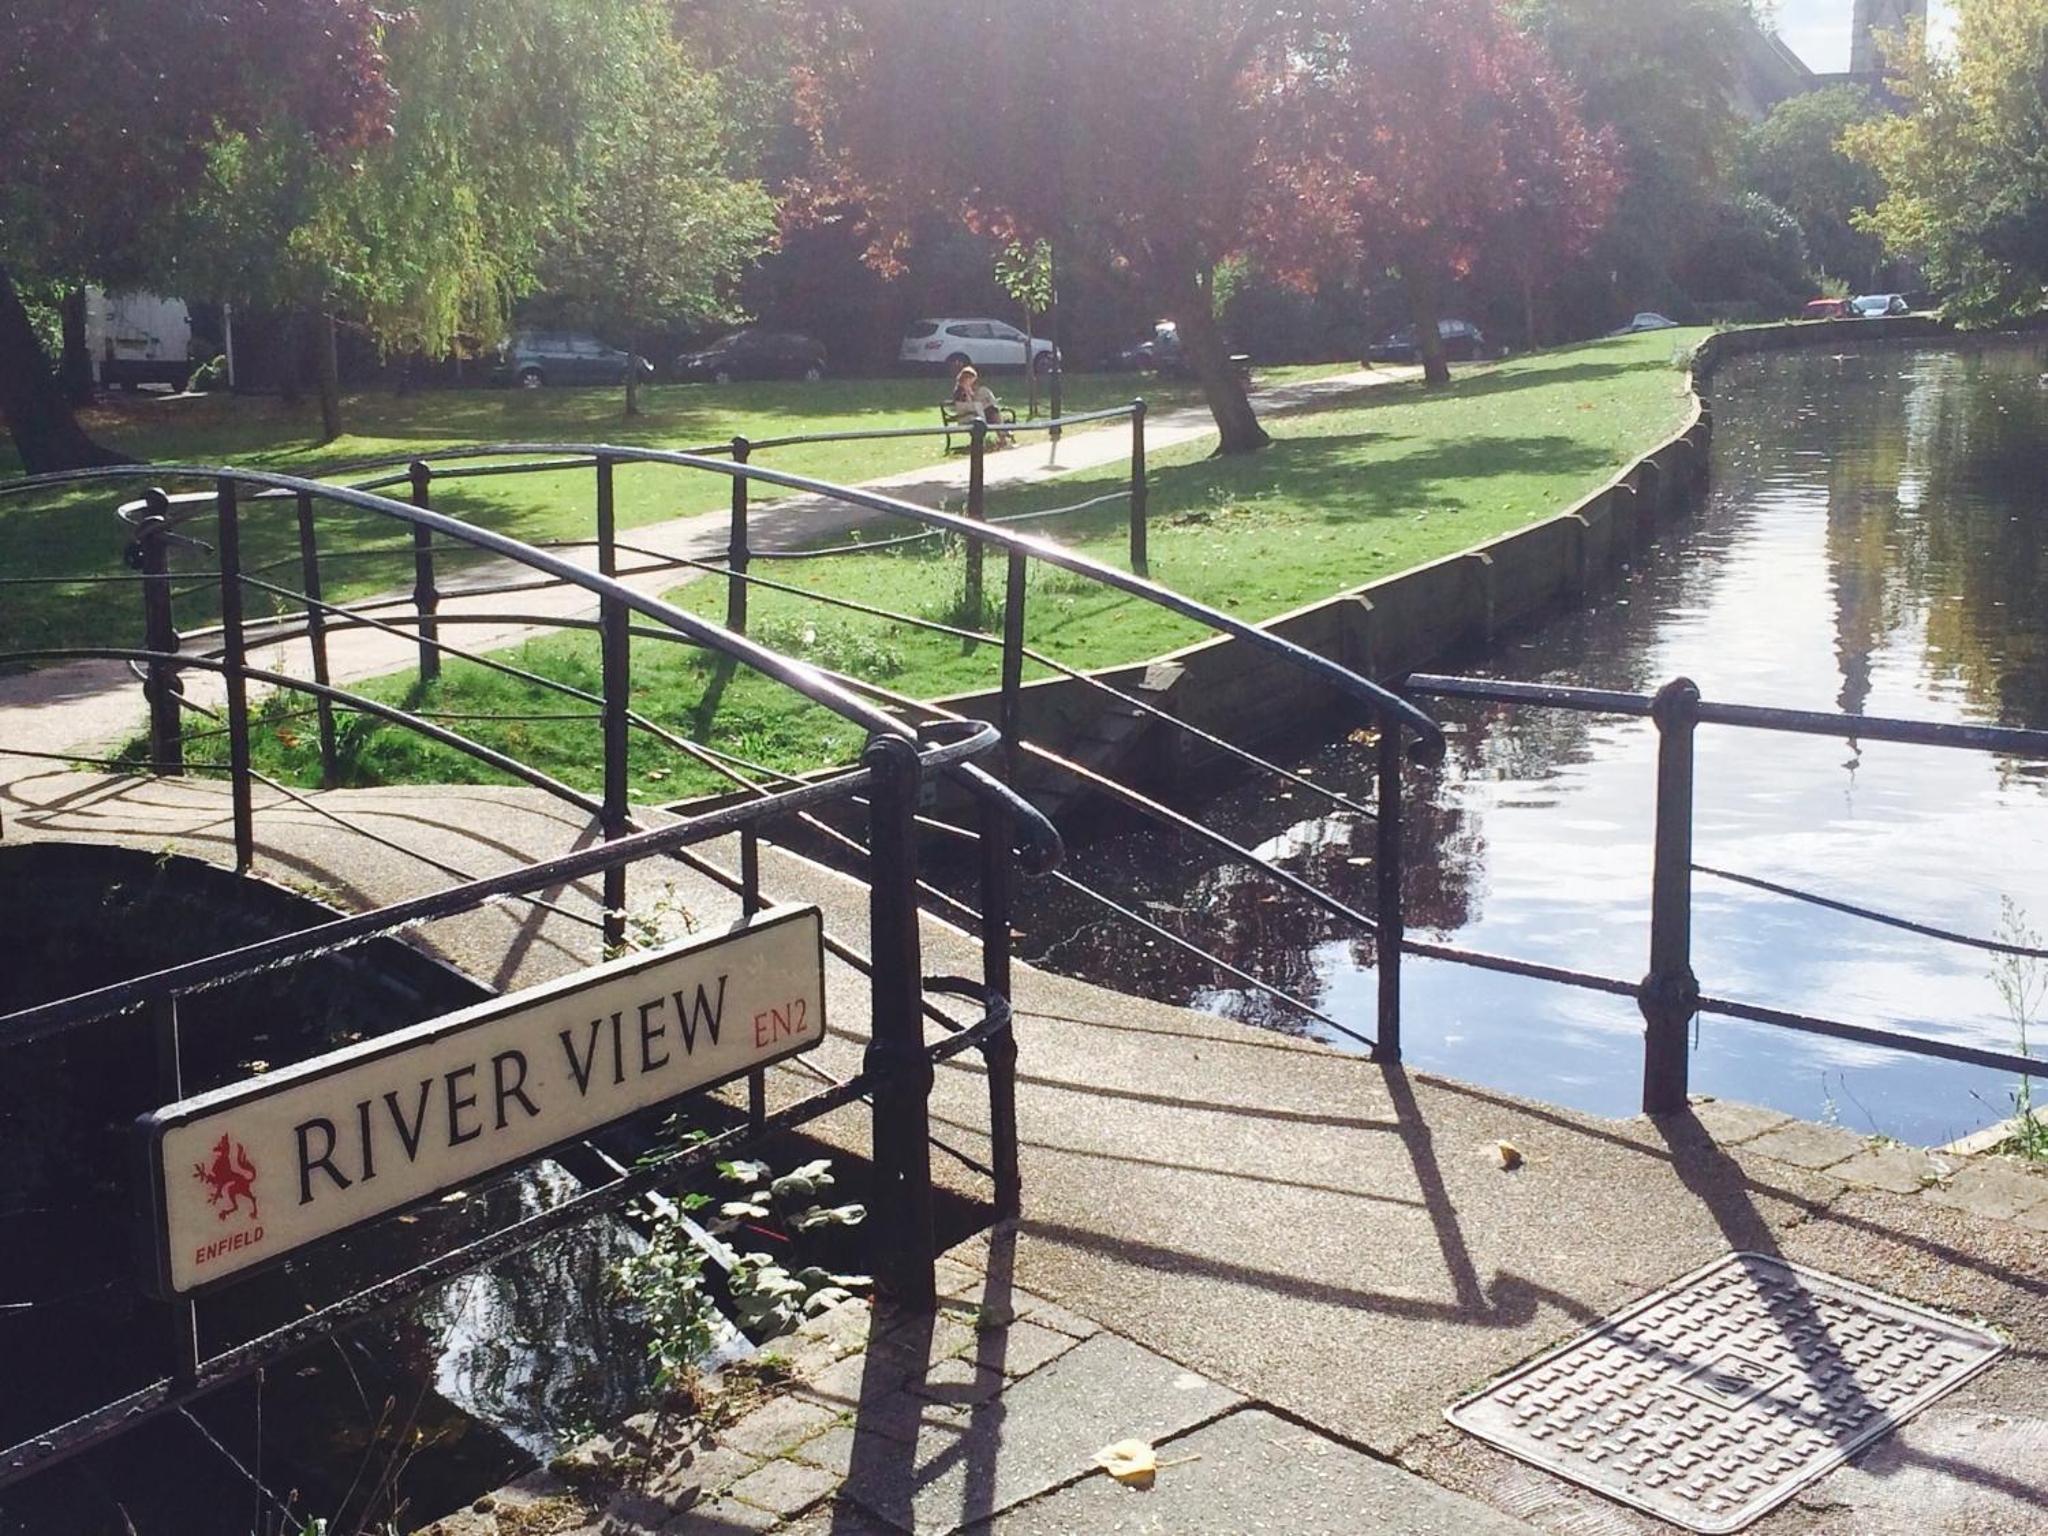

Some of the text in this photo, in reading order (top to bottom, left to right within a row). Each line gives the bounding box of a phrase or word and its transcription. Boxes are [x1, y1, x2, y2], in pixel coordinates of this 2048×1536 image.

[294, 975, 808, 1206] RIVER VIEW EN2
[195, 1225, 264, 1265] ENFIELD
[1702, 1364, 1767, 1399] CATV
